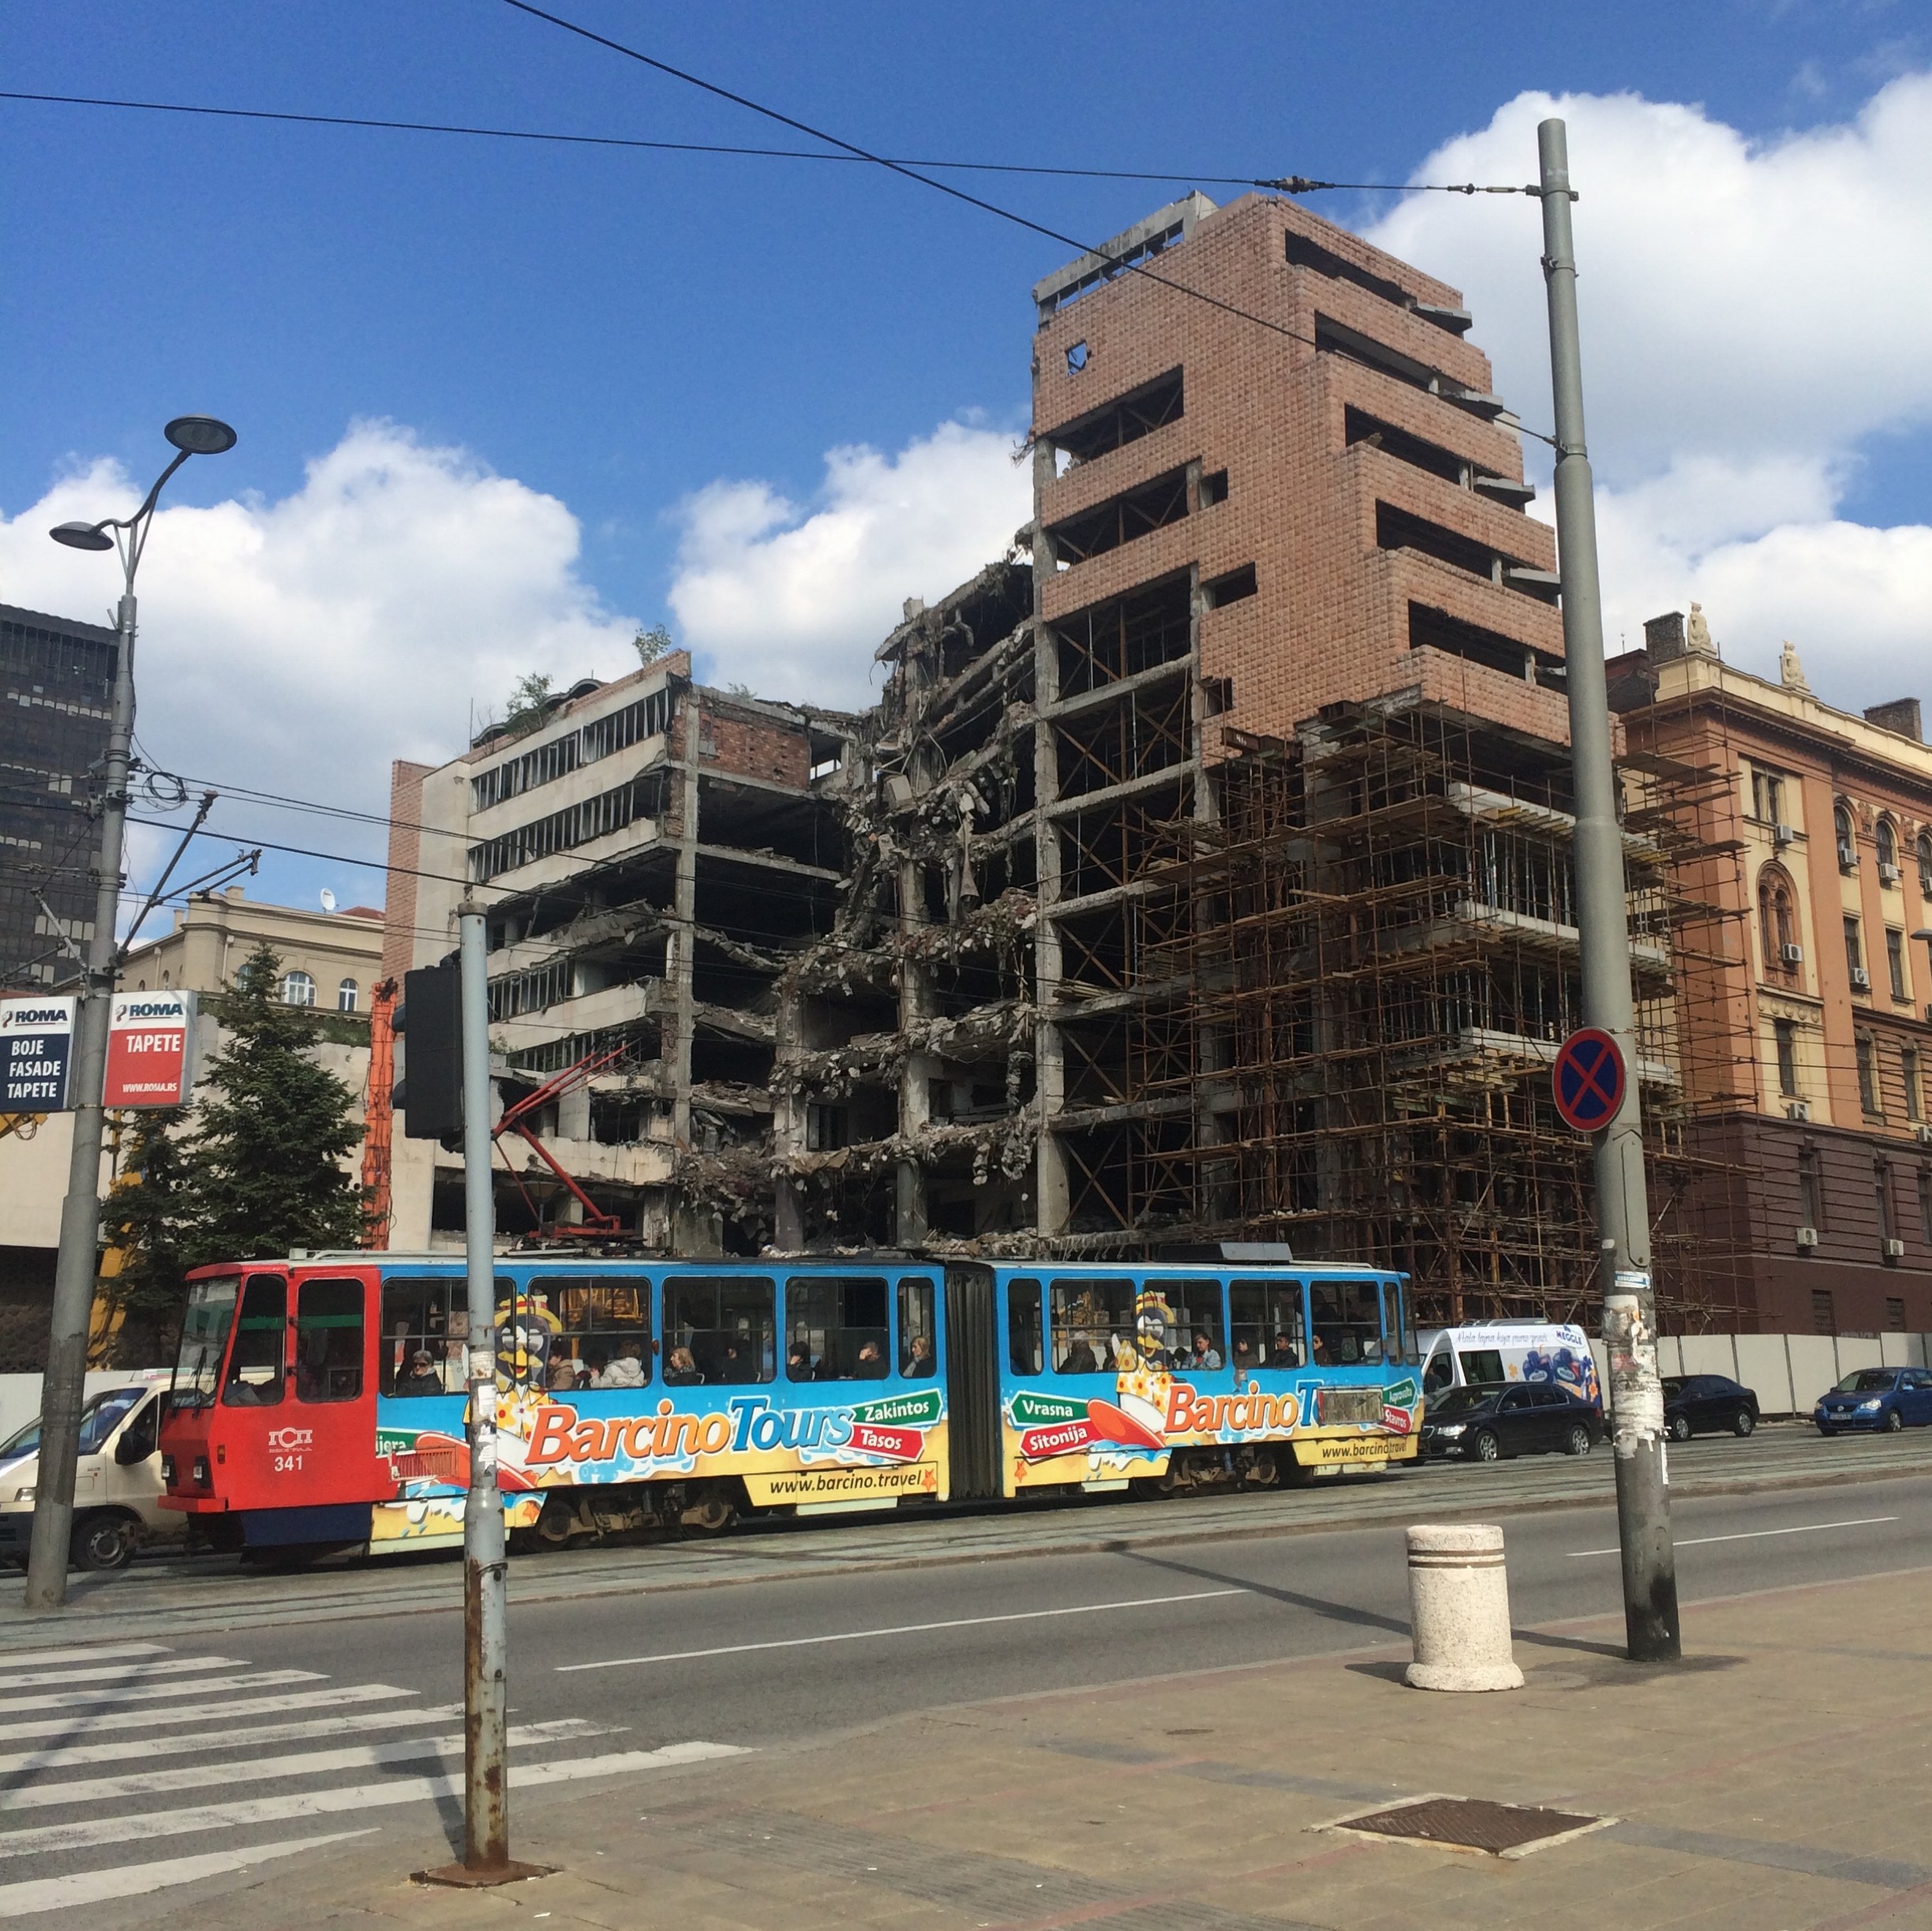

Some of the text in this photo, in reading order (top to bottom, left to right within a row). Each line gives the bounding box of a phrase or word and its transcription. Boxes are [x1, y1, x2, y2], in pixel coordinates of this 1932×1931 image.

[15, 1009, 68, 1023] ROMA
[129, 1003, 183, 1016] ROMA
[11, 1039, 44, 1056] BOJE
[126, 1034, 182, 1053] TAPETE
[9, 1060, 62, 1077] FASADE
[7, 1081, 57, 1098] TAPETE
[122, 1083, 178, 1093] WWW.ROMA.RS
[1556, 1330, 1582, 1345] MEGGLE
[864, 1399, 930, 1422] Zakintos
[1022, 1400, 1073, 1417] Vrasna
[1384, 1409, 1407, 1429] Stavros
[860, 1429, 902, 1450] Tasos
[1029, 1426, 1088, 1451] Sitonija
[274, 1454, 303, 1473] 341
[770, 1469, 922, 1494] www.barcino.travel
